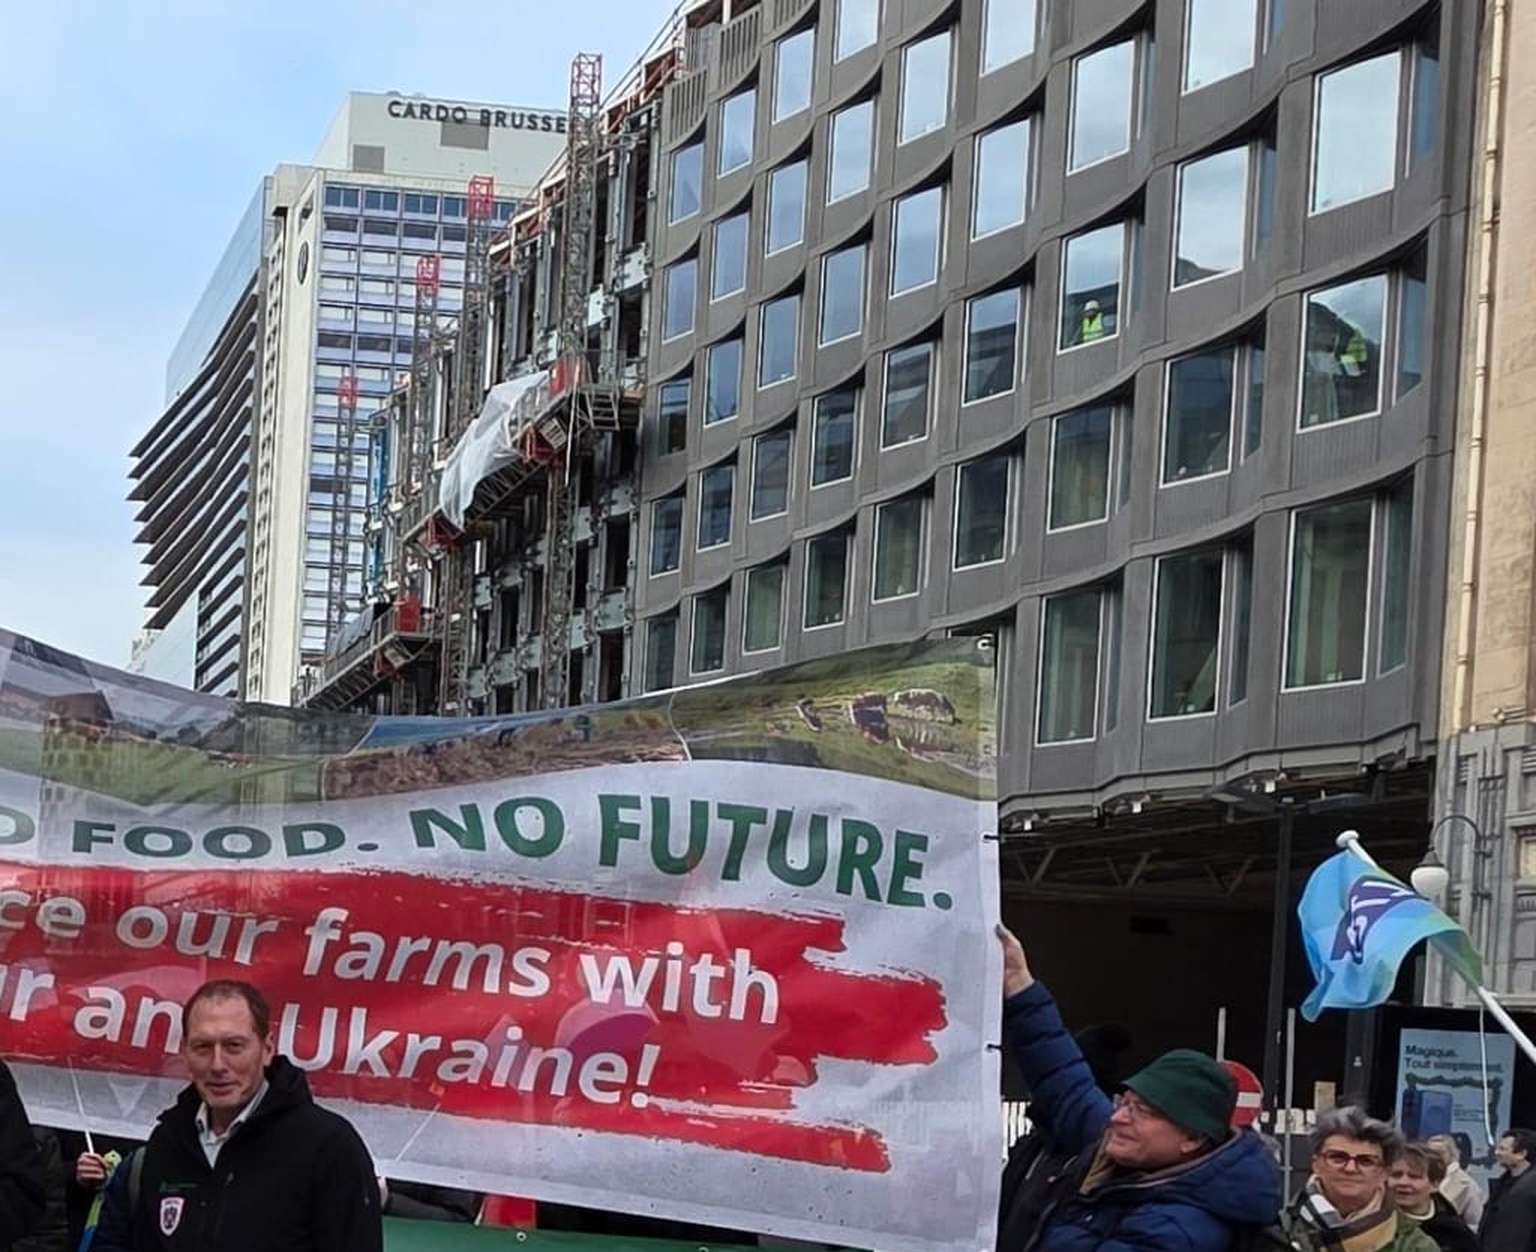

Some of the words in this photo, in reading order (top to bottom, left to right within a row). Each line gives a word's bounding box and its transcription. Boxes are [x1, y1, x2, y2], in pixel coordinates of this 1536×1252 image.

[388, 100, 466, 123] CARDO
[480, 109, 568, 133] BRUSSE
[71, 820, 379, 859] FOOD.
[409, 797, 564, 858] NO
[597, 794, 953, 910] FUTURE.
[116, 906, 279, 966] our
[303, 907, 551, 998] farms
[579, 941, 779, 1025] with
[73, 986, 186, 1054] an
[277, 1003, 661, 1109] Ukraine!
